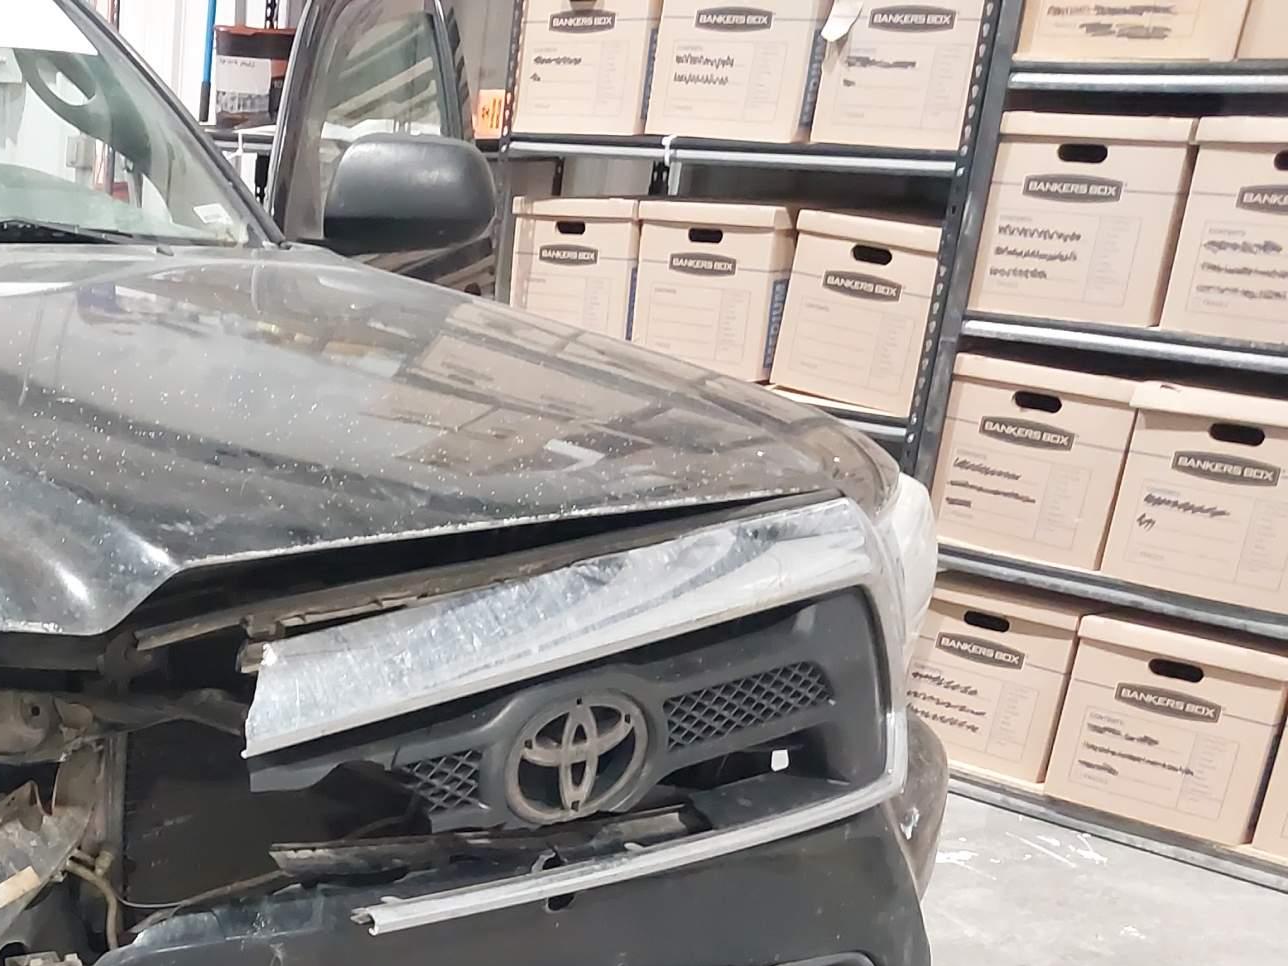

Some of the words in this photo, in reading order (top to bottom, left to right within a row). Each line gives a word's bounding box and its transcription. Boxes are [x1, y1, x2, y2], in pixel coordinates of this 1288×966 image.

[552, 16, 592, 27] BANKERS
[593, 16, 612, 26] BOX
[699, 14, 745, 25] BANKERS
[746, 15, 768, 25] BOX
[873, 13, 926, 25] BANKERS
[926, 13, 952, 25] BOX
[1028, 181, 1088, 194] BANKERS
[1088, 184, 1117, 196] BOX
[541, 249, 578, 260] BANKERS
[578, 251, 595, 260] BOX
[672, 257, 713, 270] BANKERS
[713, 261, 732, 271] BOX
[826, 275, 874, 293] BANKERS
[874, 284, 897, 297] BOX
[984, 421, 1041, 440] BANKERS
[1042, 433, 1069, 446] BOX
[1178, 456, 1242, 476] BANKERS
[1243, 467, 1274, 481] BOX
[940, 637, 994, 658] BANKERS
[994, 650, 1019, 665] BOX
[1120, 688, 1184, 711] BANKERS
[1185, 703, 1215, 718] BOX
